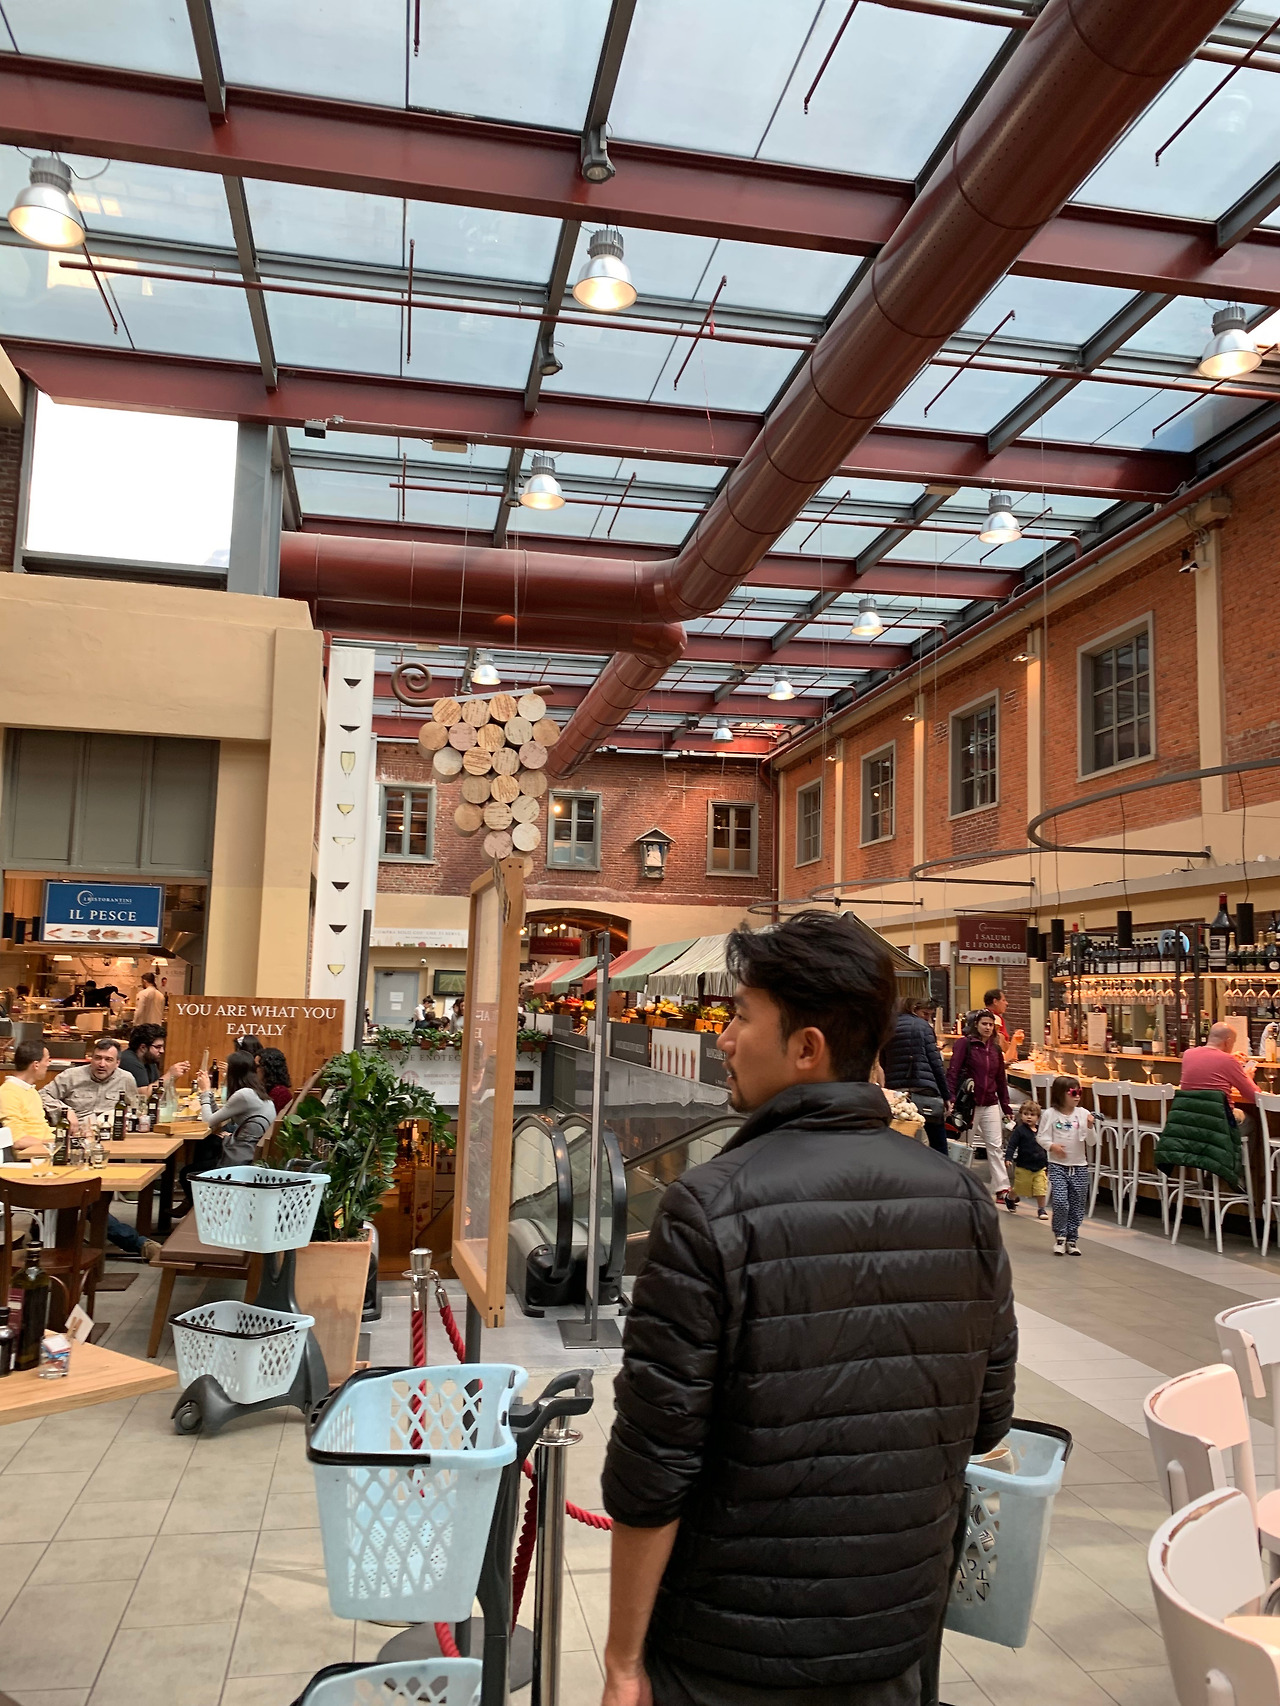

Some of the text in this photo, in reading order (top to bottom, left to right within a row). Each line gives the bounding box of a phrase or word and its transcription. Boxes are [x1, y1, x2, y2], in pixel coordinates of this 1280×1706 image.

[69, 909, 137, 922] IL PESCE
[978, 942, 1021, 950] FORMAGGI
[176, 1003, 337, 1020] YOU ARE WHAT YOU
[226, 1023, 287, 1036] EATALY
